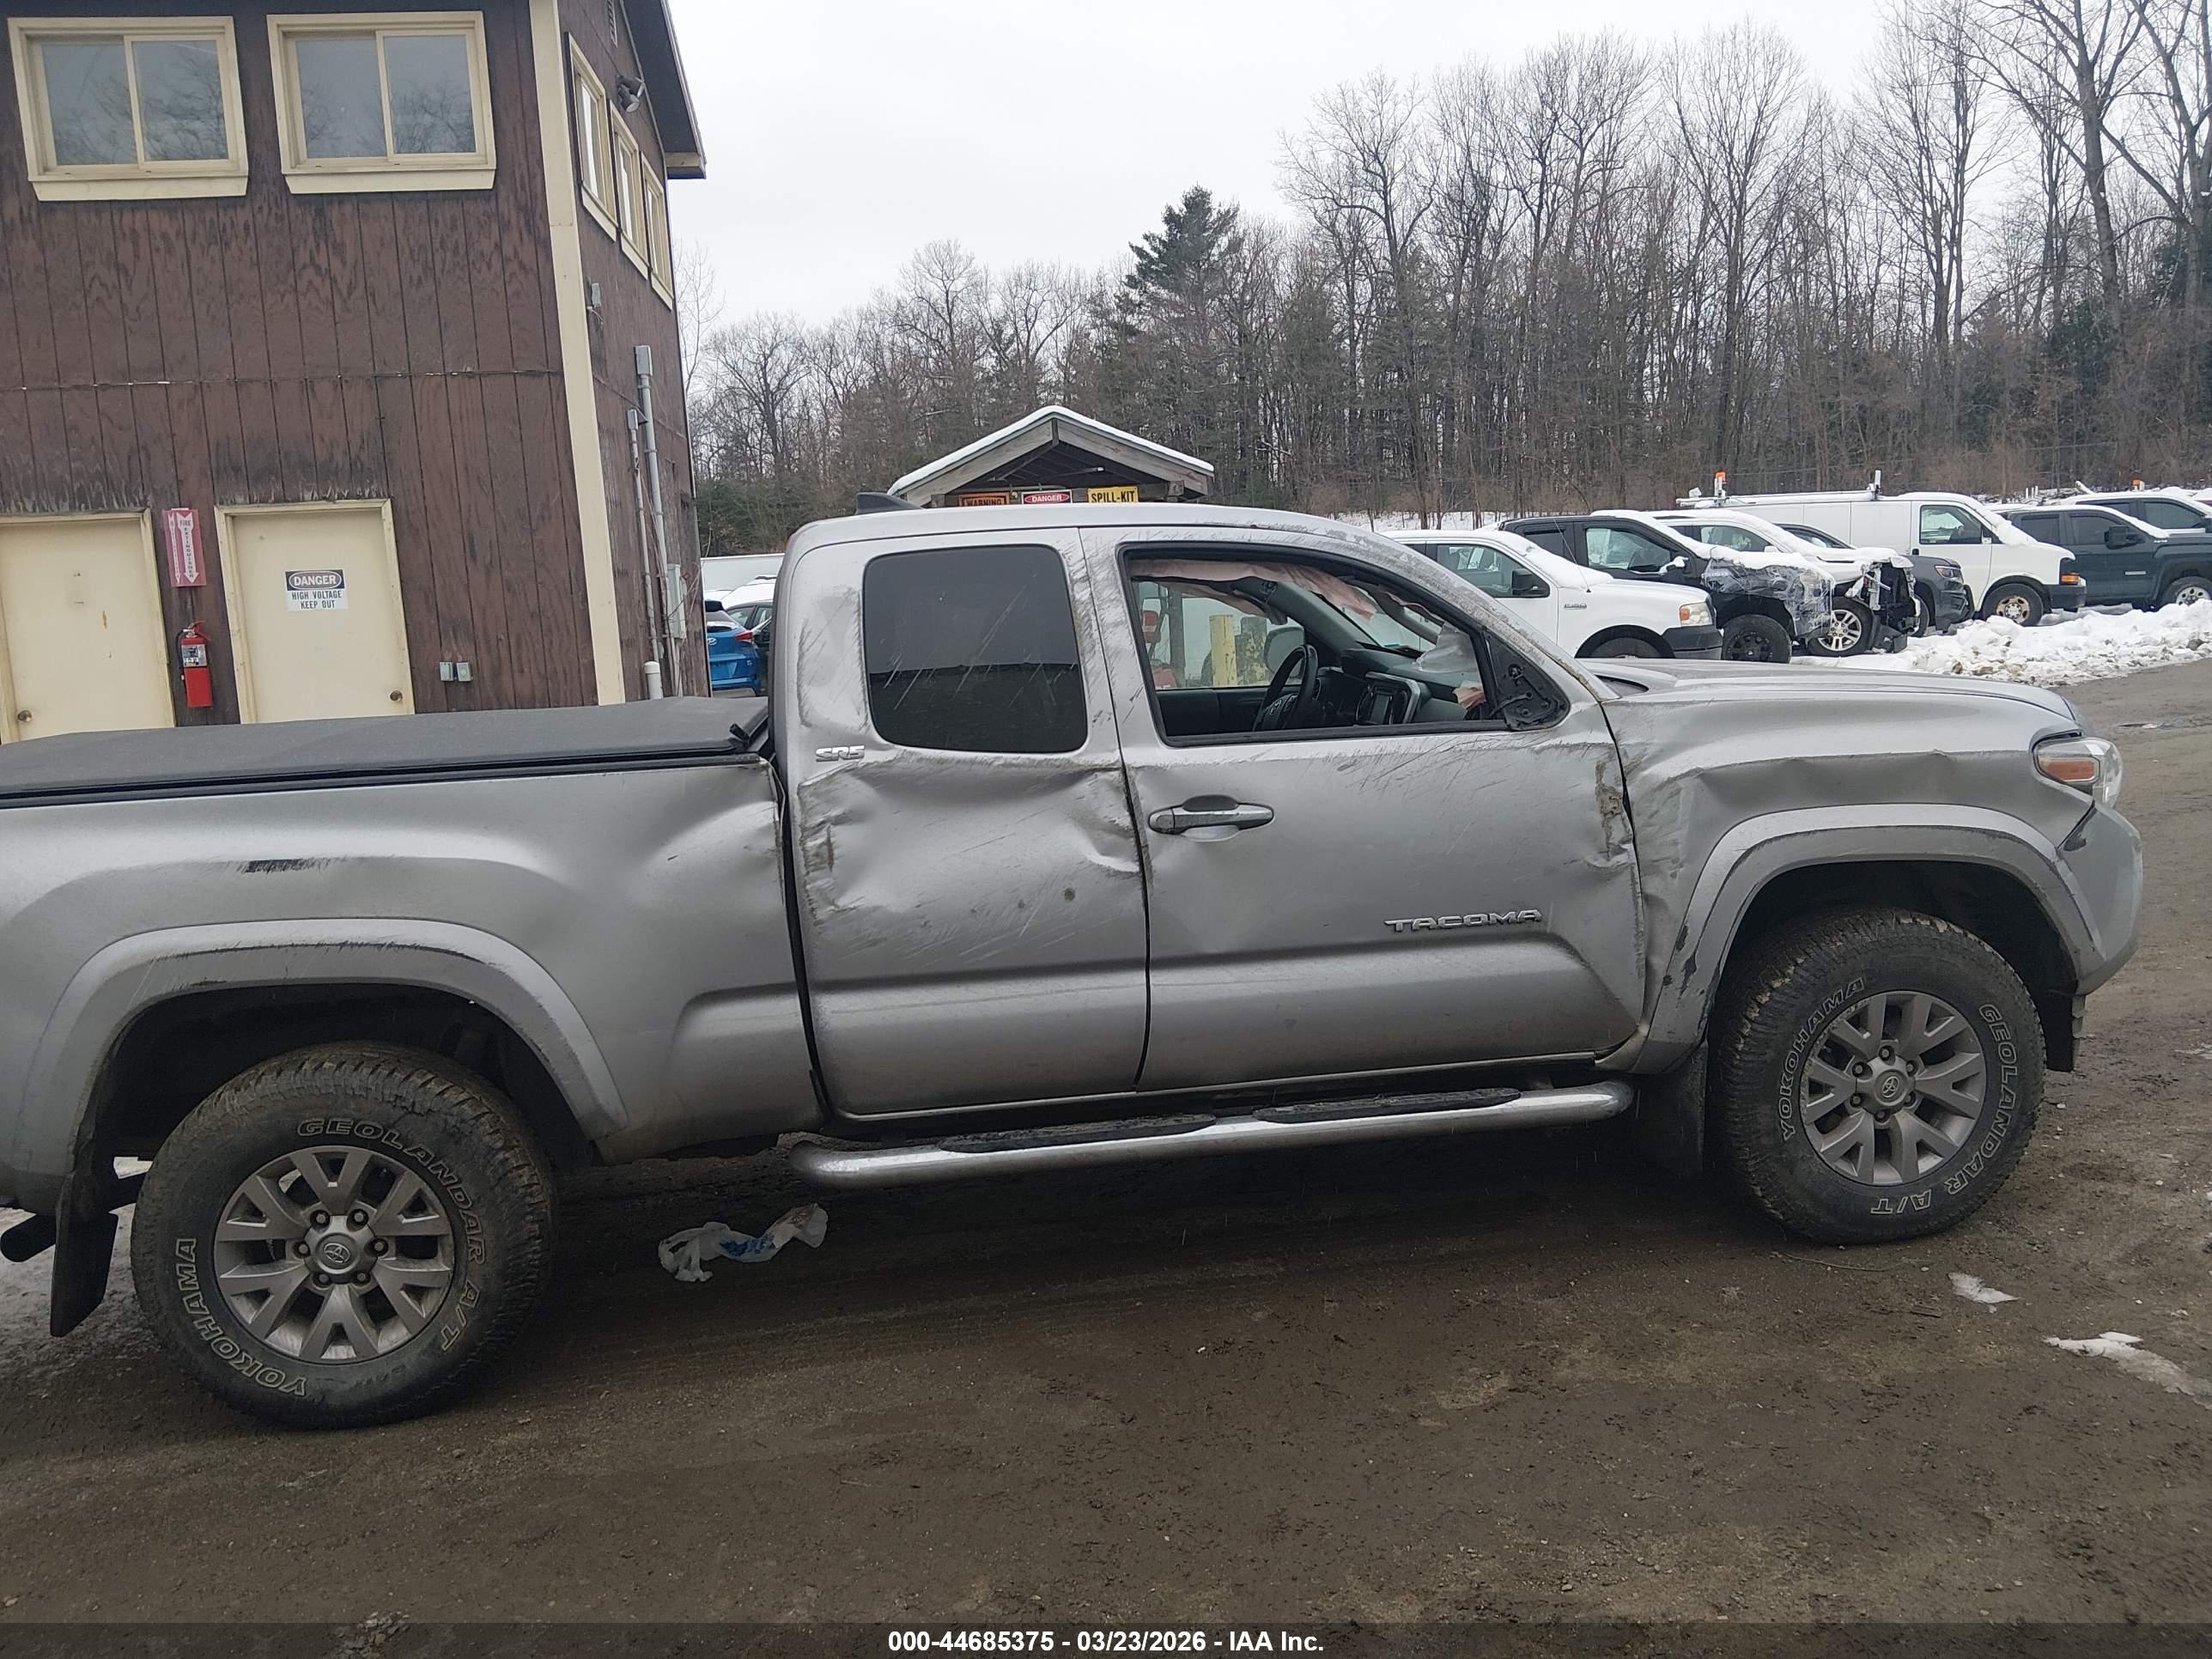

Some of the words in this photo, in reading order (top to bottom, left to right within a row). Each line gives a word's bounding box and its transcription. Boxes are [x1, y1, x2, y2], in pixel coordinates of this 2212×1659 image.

[1031, 494, 1062, 502] DANGER
[1091, 490, 1134, 502] SPILL-KIT
[184, 526, 194, 578] EXTINGUISHER
[294, 574, 337, 586] DANGER
[292, 591, 309, 600] HIGH
[313, 590, 342, 599] VOLTAGE
[301, 600, 318, 610] KEEP
[322, 599, 336, 609] OUT
[1383, 909, 1543, 933] TACOMA
[1778, 977, 1865, 1140] YOKOHAMA
[1944, 1004, 2017, 1195] GEOLANDAR
[1870, 1188, 1933, 1214] A/T
[297, 1119, 486, 1265] GEOLANDAR
[439, 1279, 482, 1352] A/T
[174, 1237, 308, 1398] YOKOHAMA
